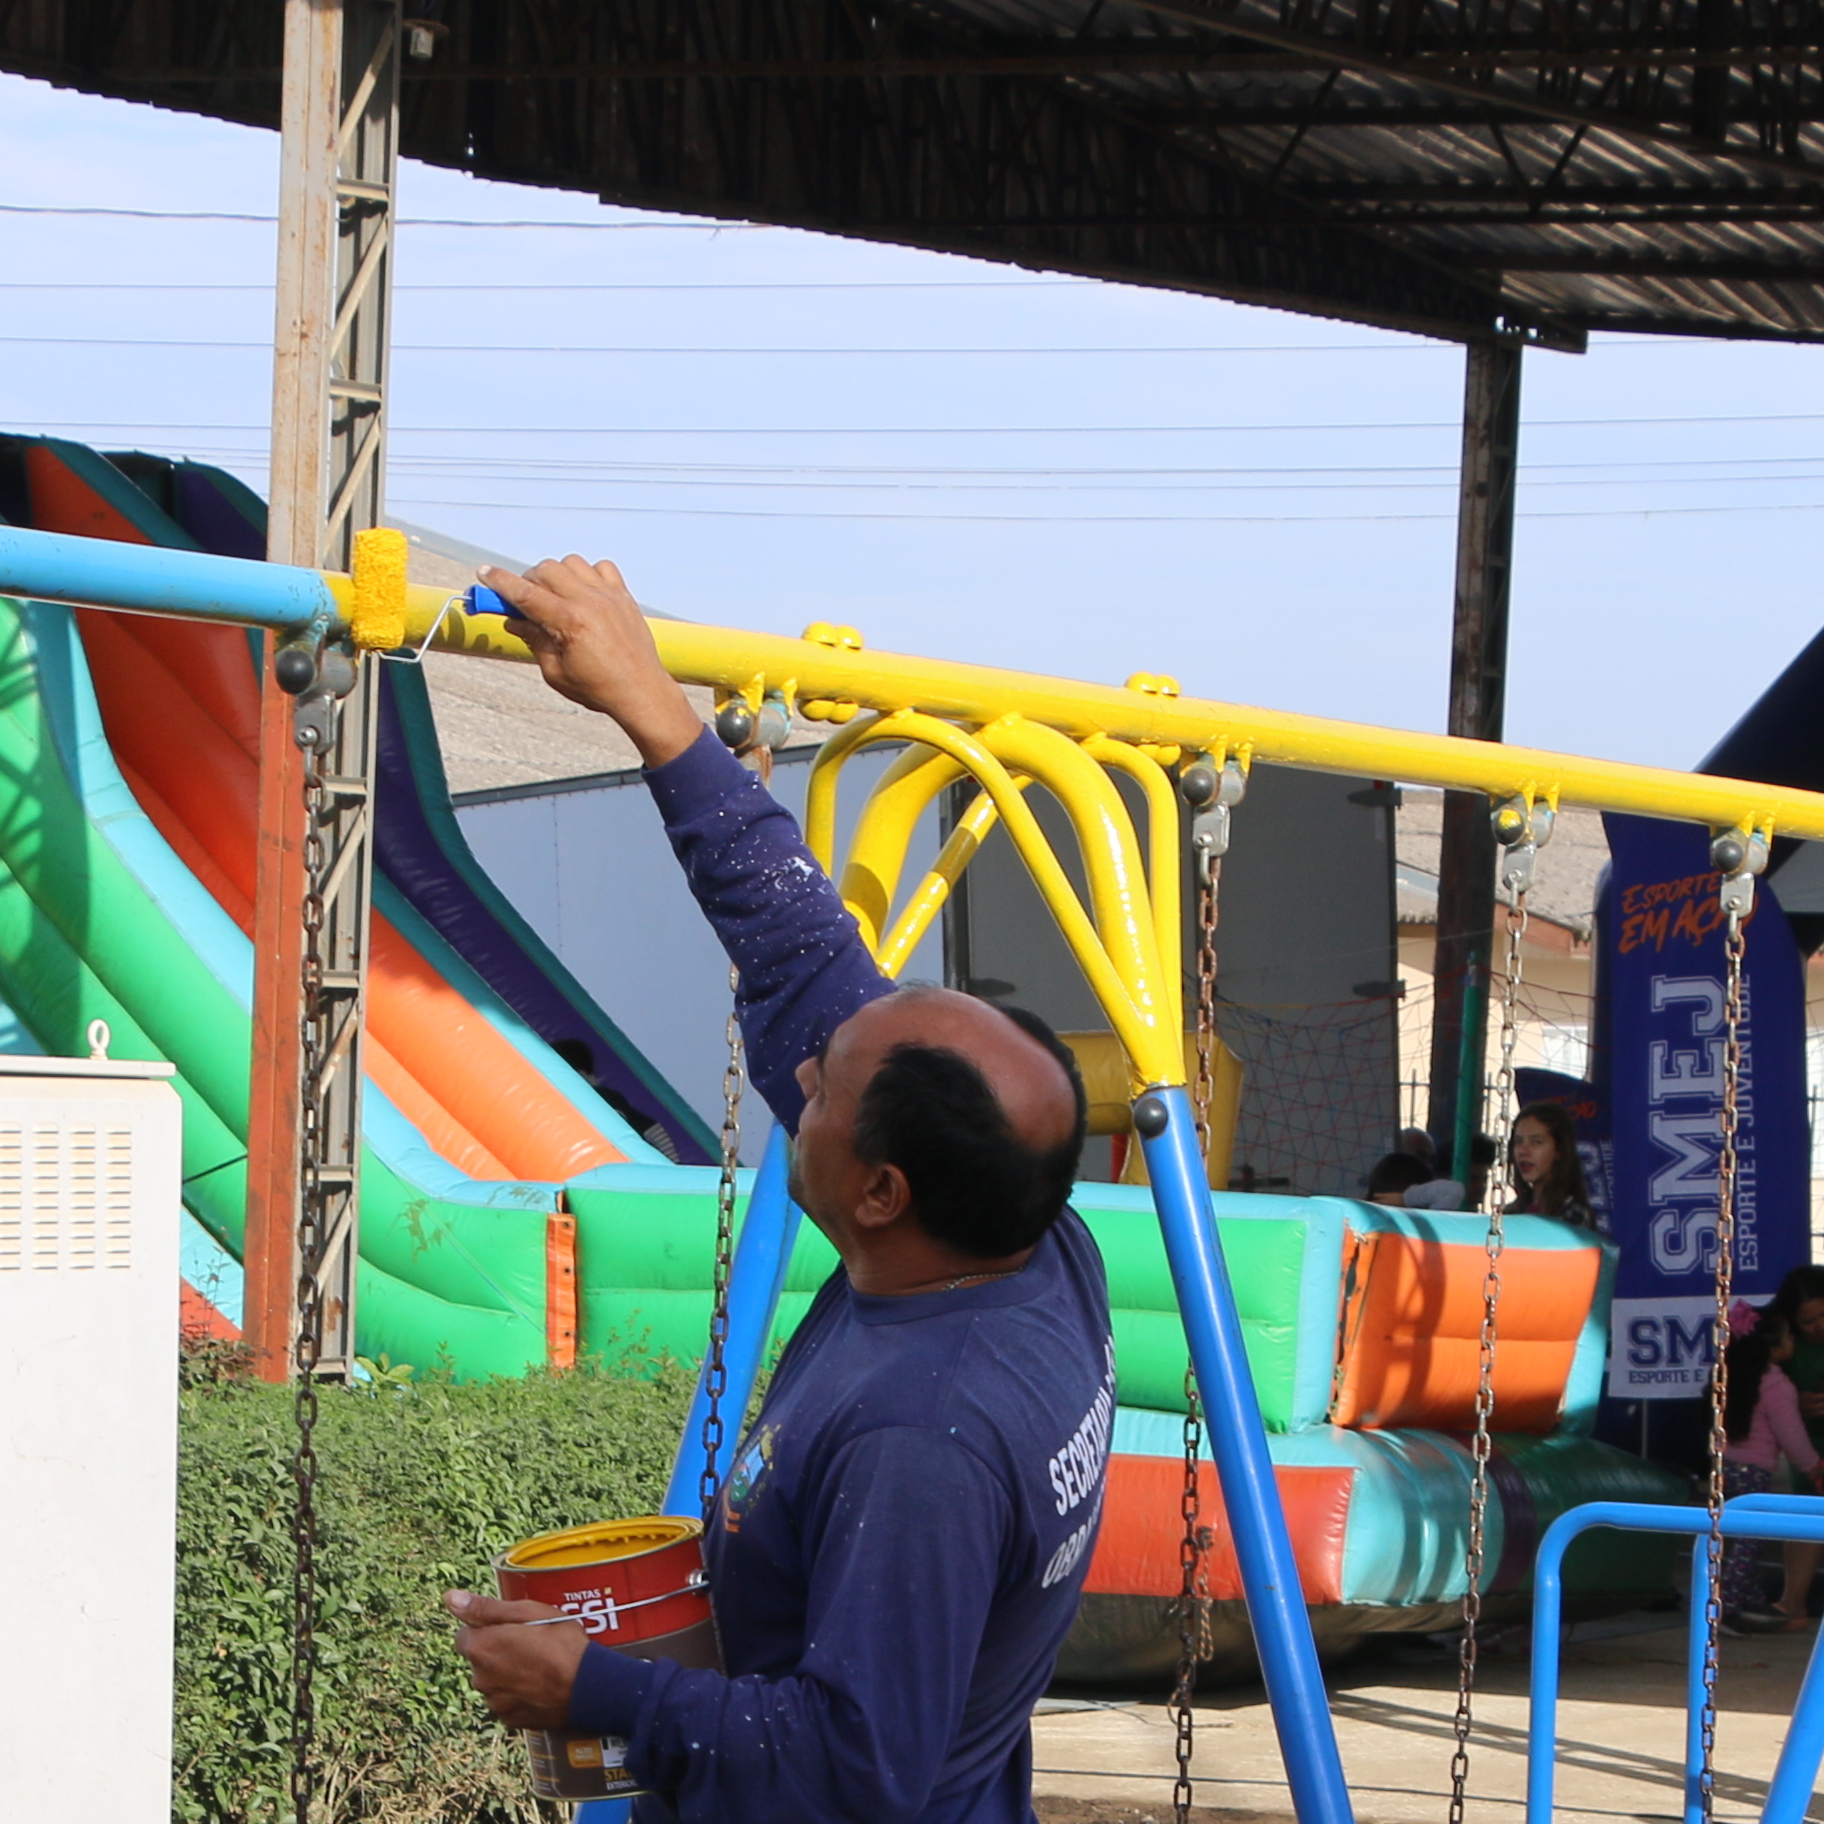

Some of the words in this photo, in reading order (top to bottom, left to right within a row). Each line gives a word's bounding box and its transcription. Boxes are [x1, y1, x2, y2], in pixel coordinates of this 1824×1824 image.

[1622, 871, 1723, 914] ESPORTE
[1619, 908, 1670, 954] EM
[1649, 974, 1732, 1275] SMEJ
[1736, 1135, 1756, 1152] E
[1736, 1158, 1758, 1272] ESPORTE
[1629, 1369, 1689, 1384] ESPORTE
[563, 1588, 601, 1602] TINTAS
